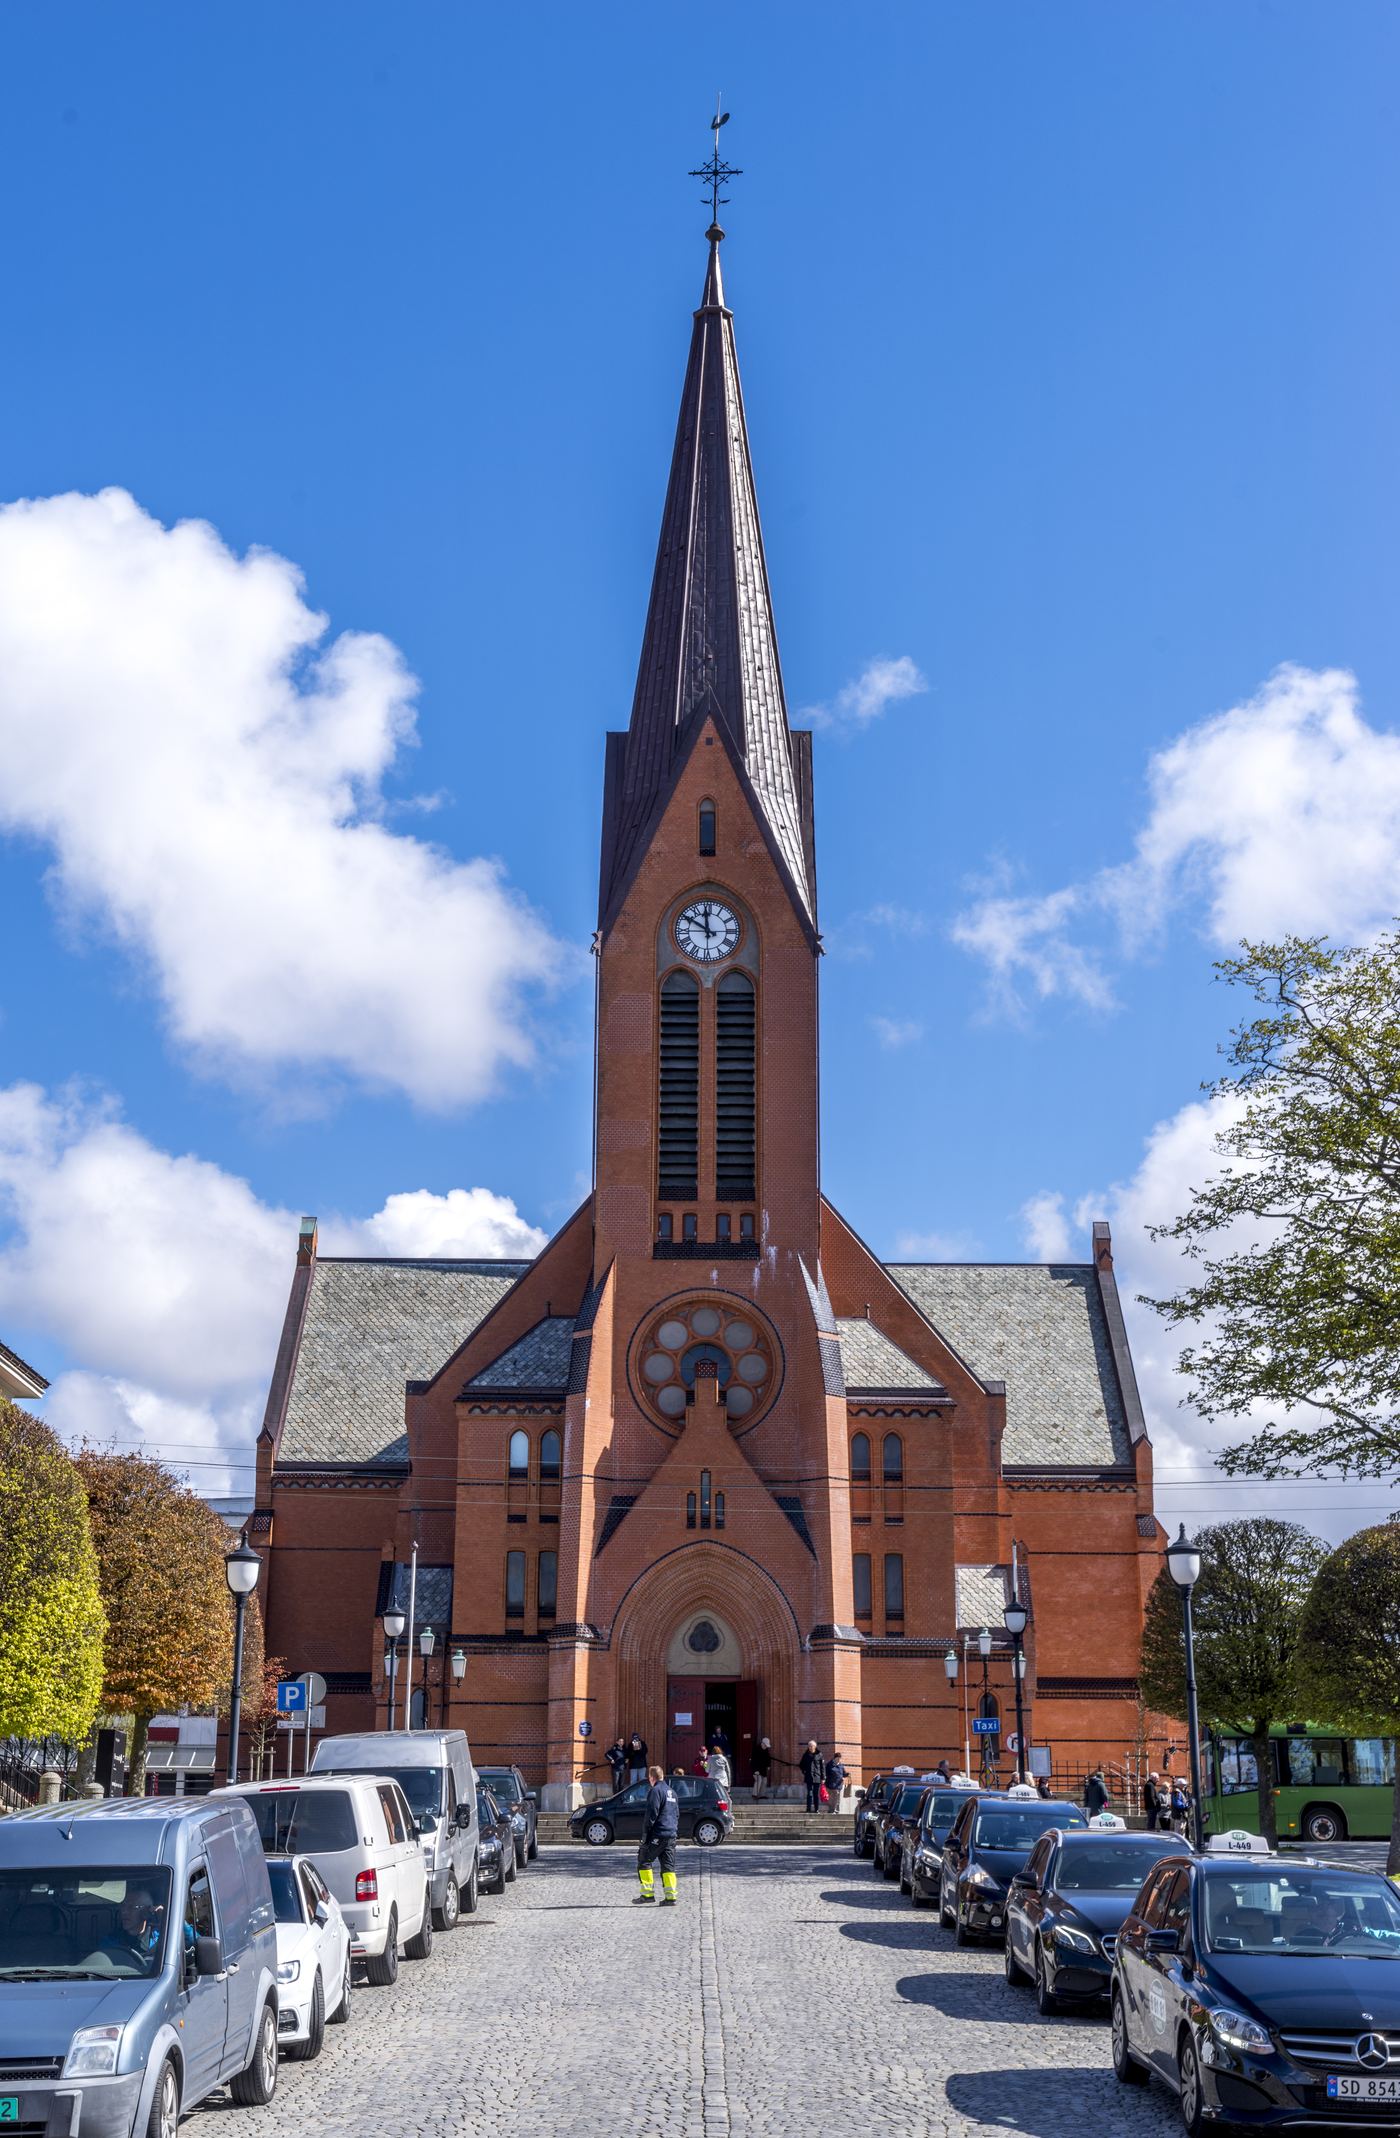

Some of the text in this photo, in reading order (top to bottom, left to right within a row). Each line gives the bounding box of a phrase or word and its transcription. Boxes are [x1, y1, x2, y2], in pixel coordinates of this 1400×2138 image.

[285, 1686, 300, 1708] P
[976, 1720, 997, 1730] Taxi
[1228, 1841, 1252, 1850] L-449
[1341, 2080, 1360, 2095] SD
